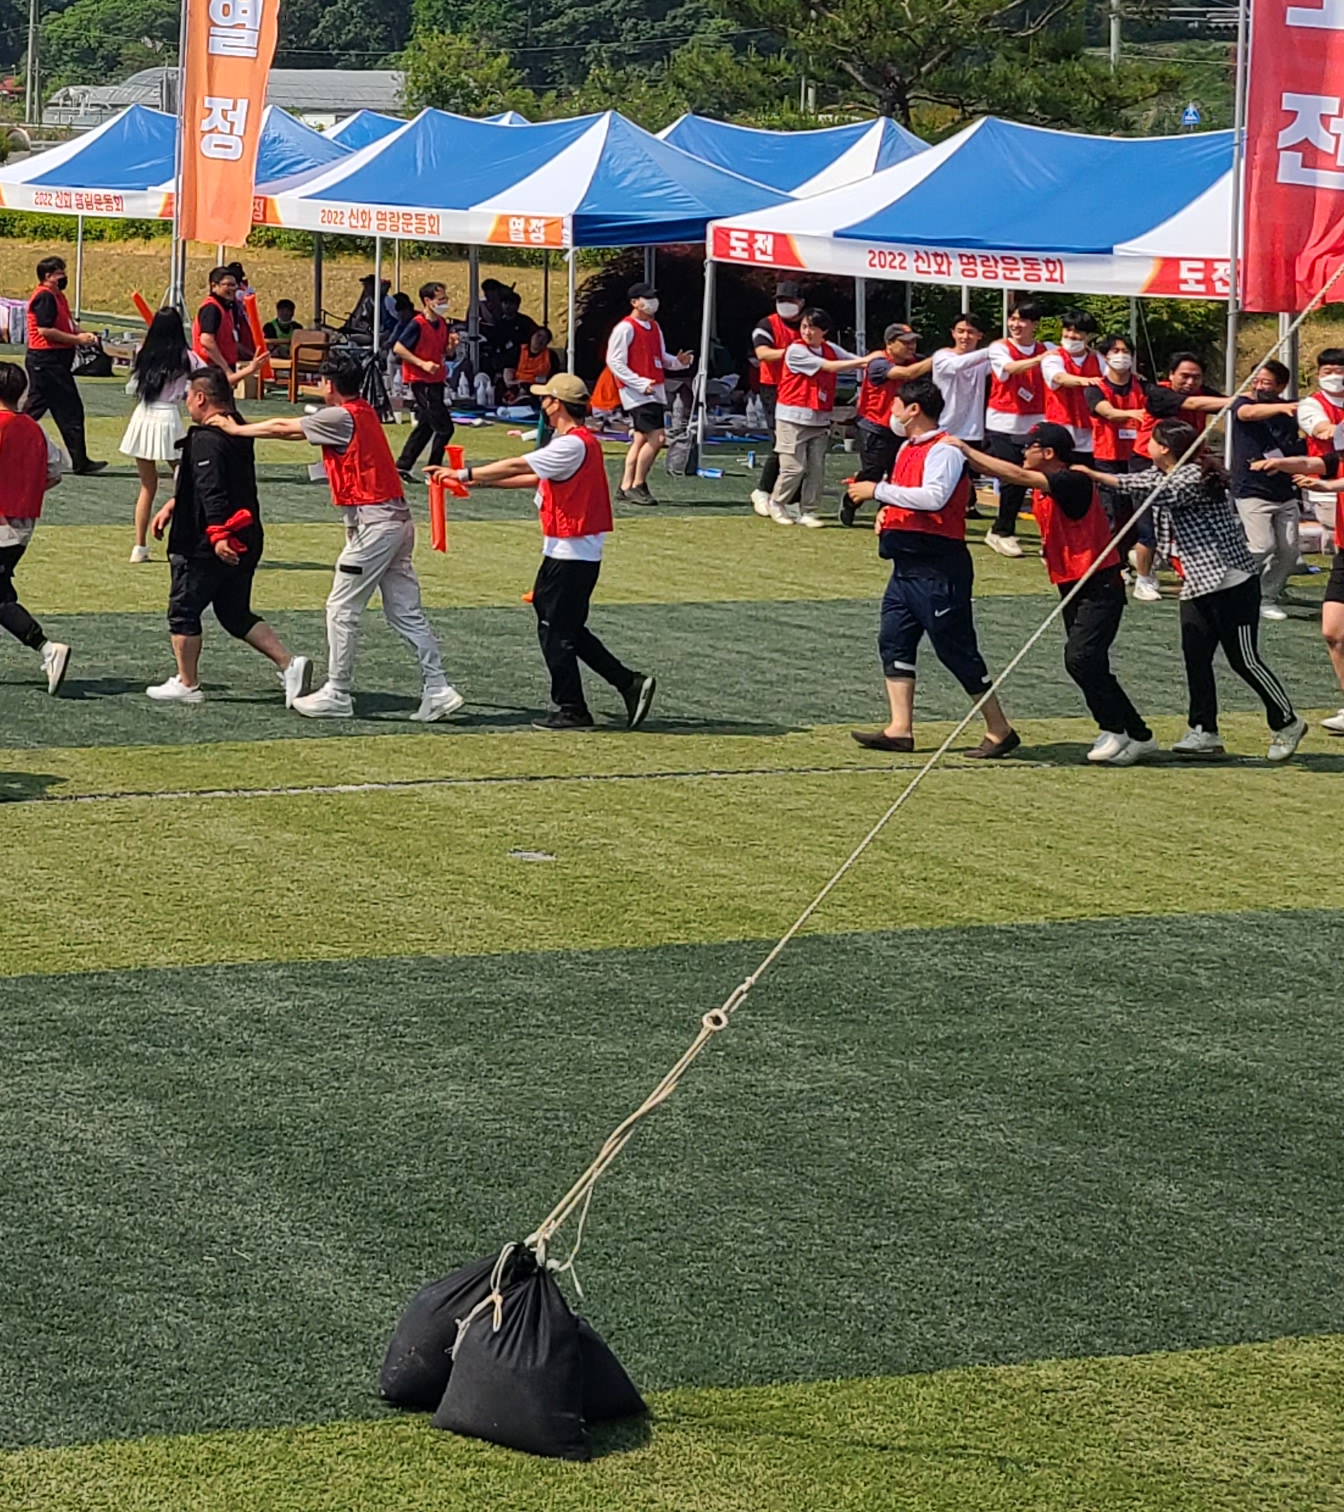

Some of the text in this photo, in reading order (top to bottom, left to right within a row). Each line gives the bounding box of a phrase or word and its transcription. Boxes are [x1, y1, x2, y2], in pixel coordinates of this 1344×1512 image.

[34, 191, 53, 207] 2022
[320, 208, 441, 236] 2022 신화 명랑운동회
[509, 217, 545, 244] 열정
[729, 231, 774, 263] 도전
[867, 249, 1065, 285] 2022 신화 명랑운동회
